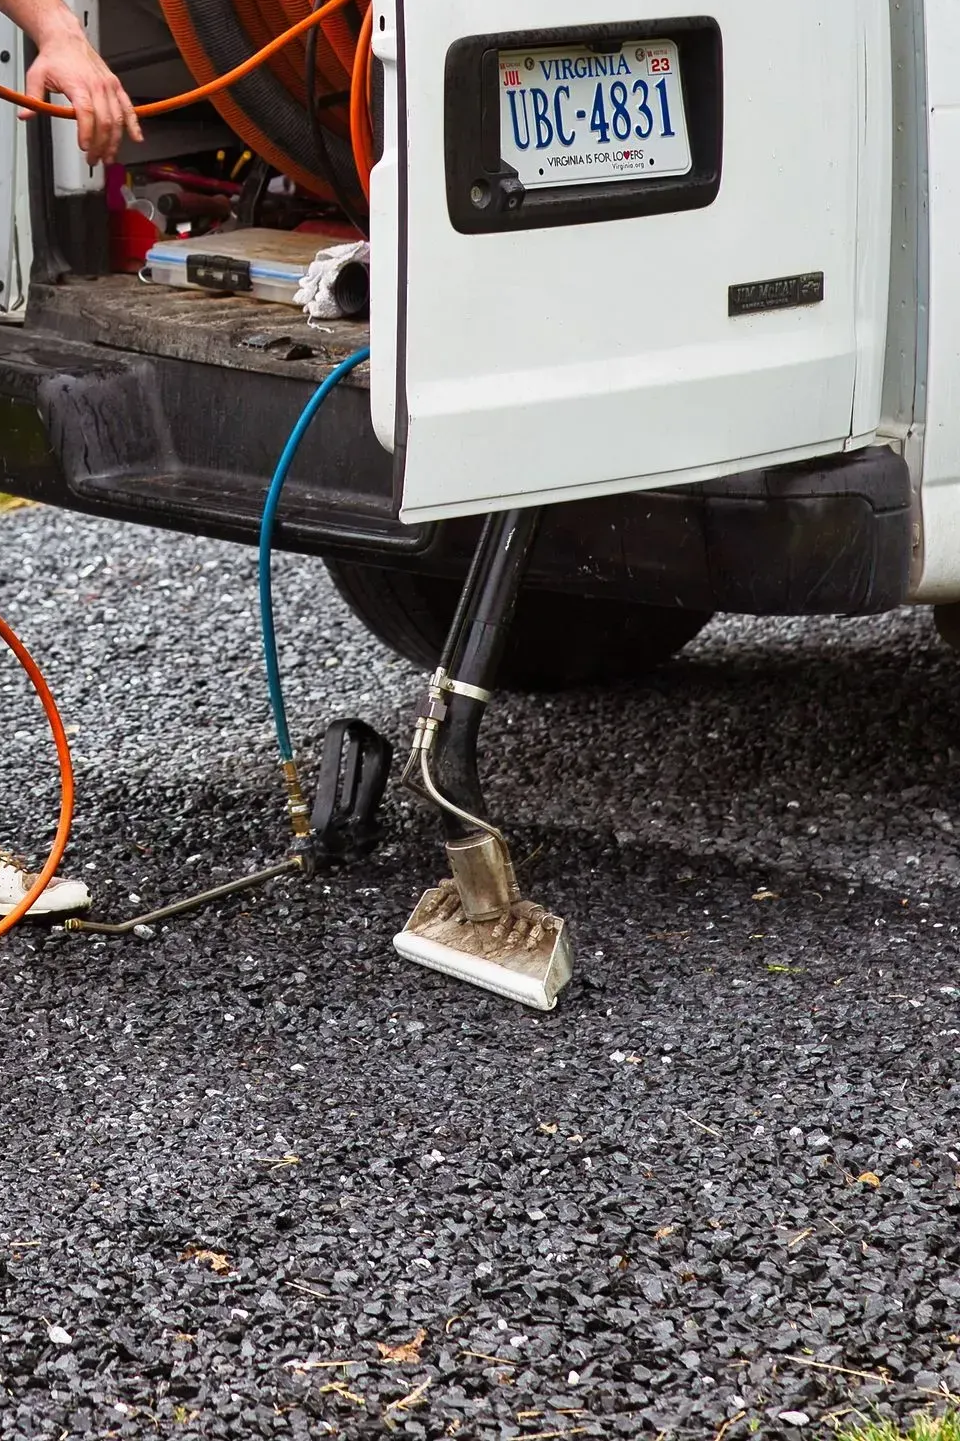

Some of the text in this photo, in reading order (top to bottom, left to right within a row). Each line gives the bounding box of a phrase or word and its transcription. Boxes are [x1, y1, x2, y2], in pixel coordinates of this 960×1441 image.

[539, 53, 632, 81] VIRGINIA
[651, 57, 671, 73] 23
[503, 70, 522, 87] JUL
[506, 77, 676, 150] UBC-4831
[546, 155, 585, 167] VIRGINIA
[585, 153, 593, 164] IS
[594, 152, 611, 163] FOR
